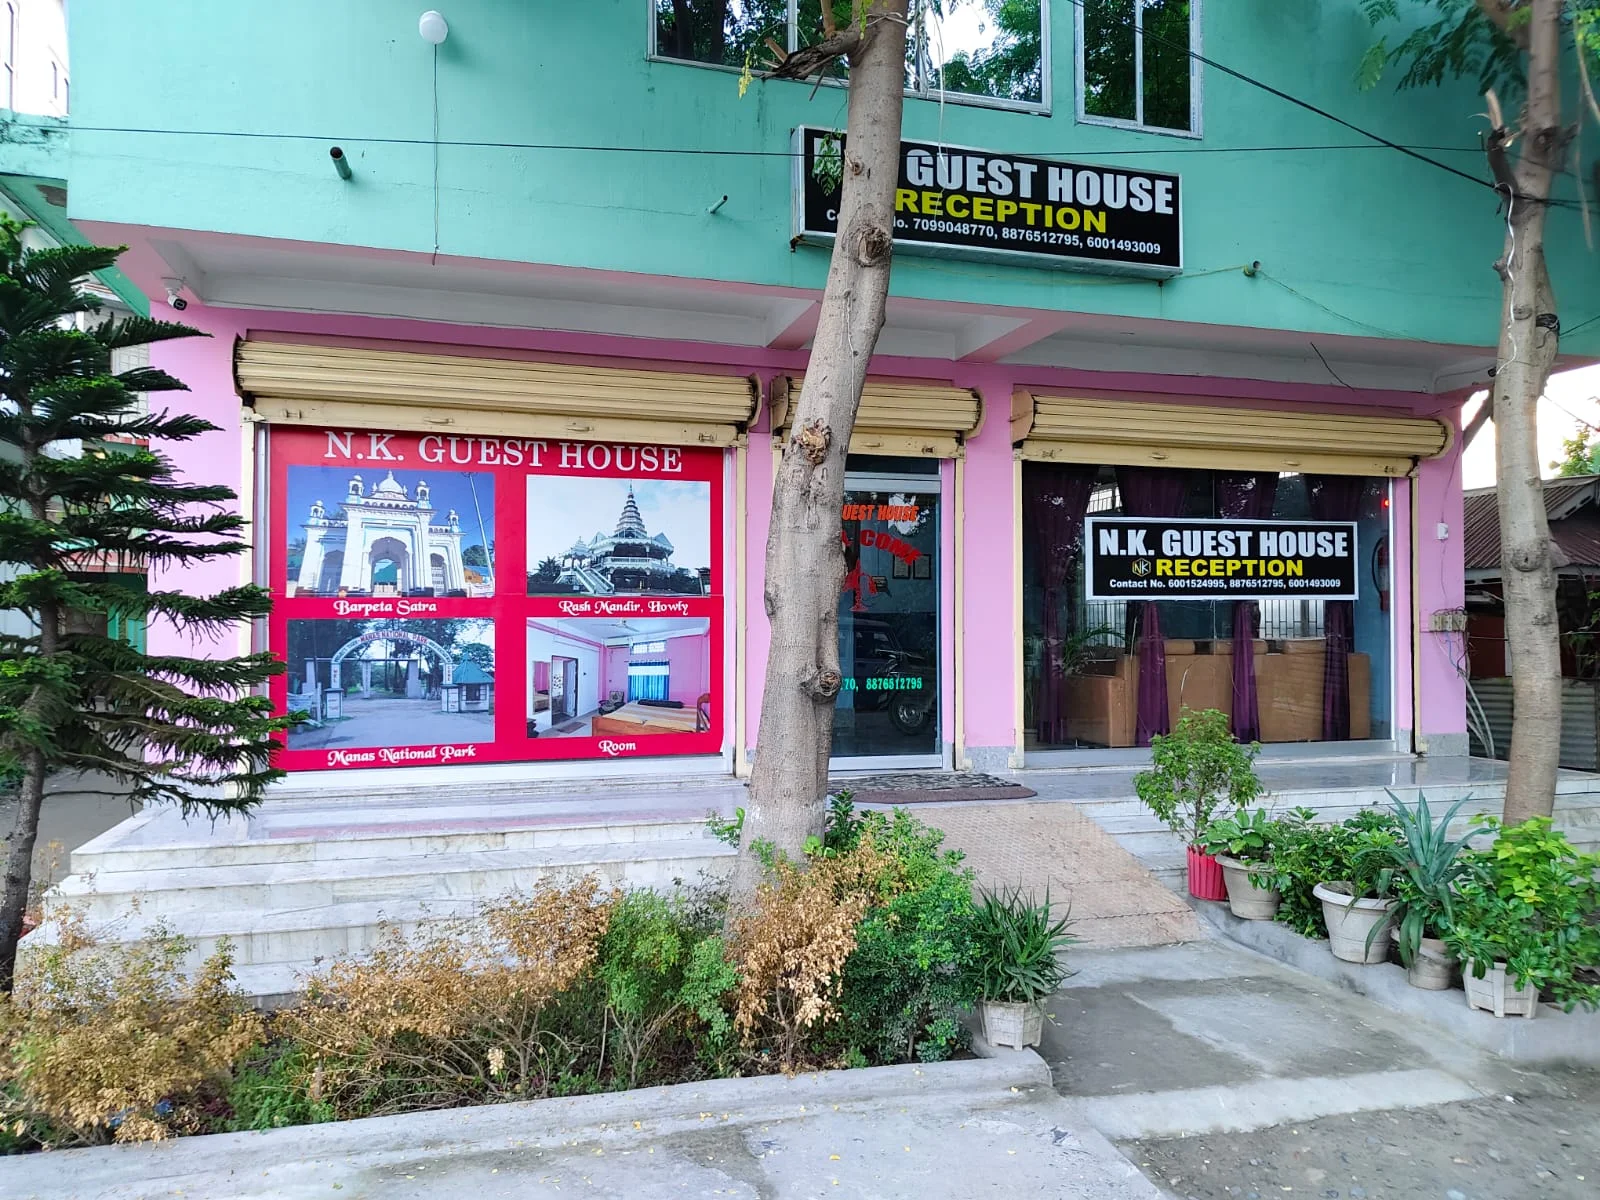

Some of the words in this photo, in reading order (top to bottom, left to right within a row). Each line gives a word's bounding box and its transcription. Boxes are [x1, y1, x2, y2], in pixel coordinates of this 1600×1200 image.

[906, 149, 1038, 200] GUEST
[1047, 166, 1173, 215] HOUSE
[895, 188, 1107, 233] RECEPTION
[893, 216, 909, 229] o.
[913, 218, 999, 240] 7099048770,
[1001, 227, 1083, 249] 8876512795,
[1086, 237, 1161, 255] 6001493009
[323, 431, 404, 461] N.K.
[418, 435, 547, 468] GUEST
[558, 443, 683, 473] HOUSE
[842, 505, 875, 520] UEST
[877, 505, 919, 522] HOUSE
[1099, 529, 1155, 556] N.K.
[1162, 530, 1252, 556] GUEST
[1259, 532, 1348, 557] HOUSE
[1156, 559, 1303, 577] RECEPTION
[1109, 579, 1148, 588] Contact
[1150, 579, 1166, 588] No.
[1168, 579, 1227, 589] 6001524995,
[1229, 579, 1286, 589] 8876512795,
[1288, 579, 1341, 588] 6001493009
[333, 600, 393, 616] Barpeta
[396, 600, 437, 615] Satra
[558, 601, 591, 616] Rash
[594, 601, 644, 615] Mandir,
[647, 601, 688, 616] Howly
[866, 677, 922, 690] 8876512795
[327, 750, 375, 766] Manas
[378, 746, 436, 764] National
[440, 744, 476, 762] Park
[598, 740, 636, 756] Room
